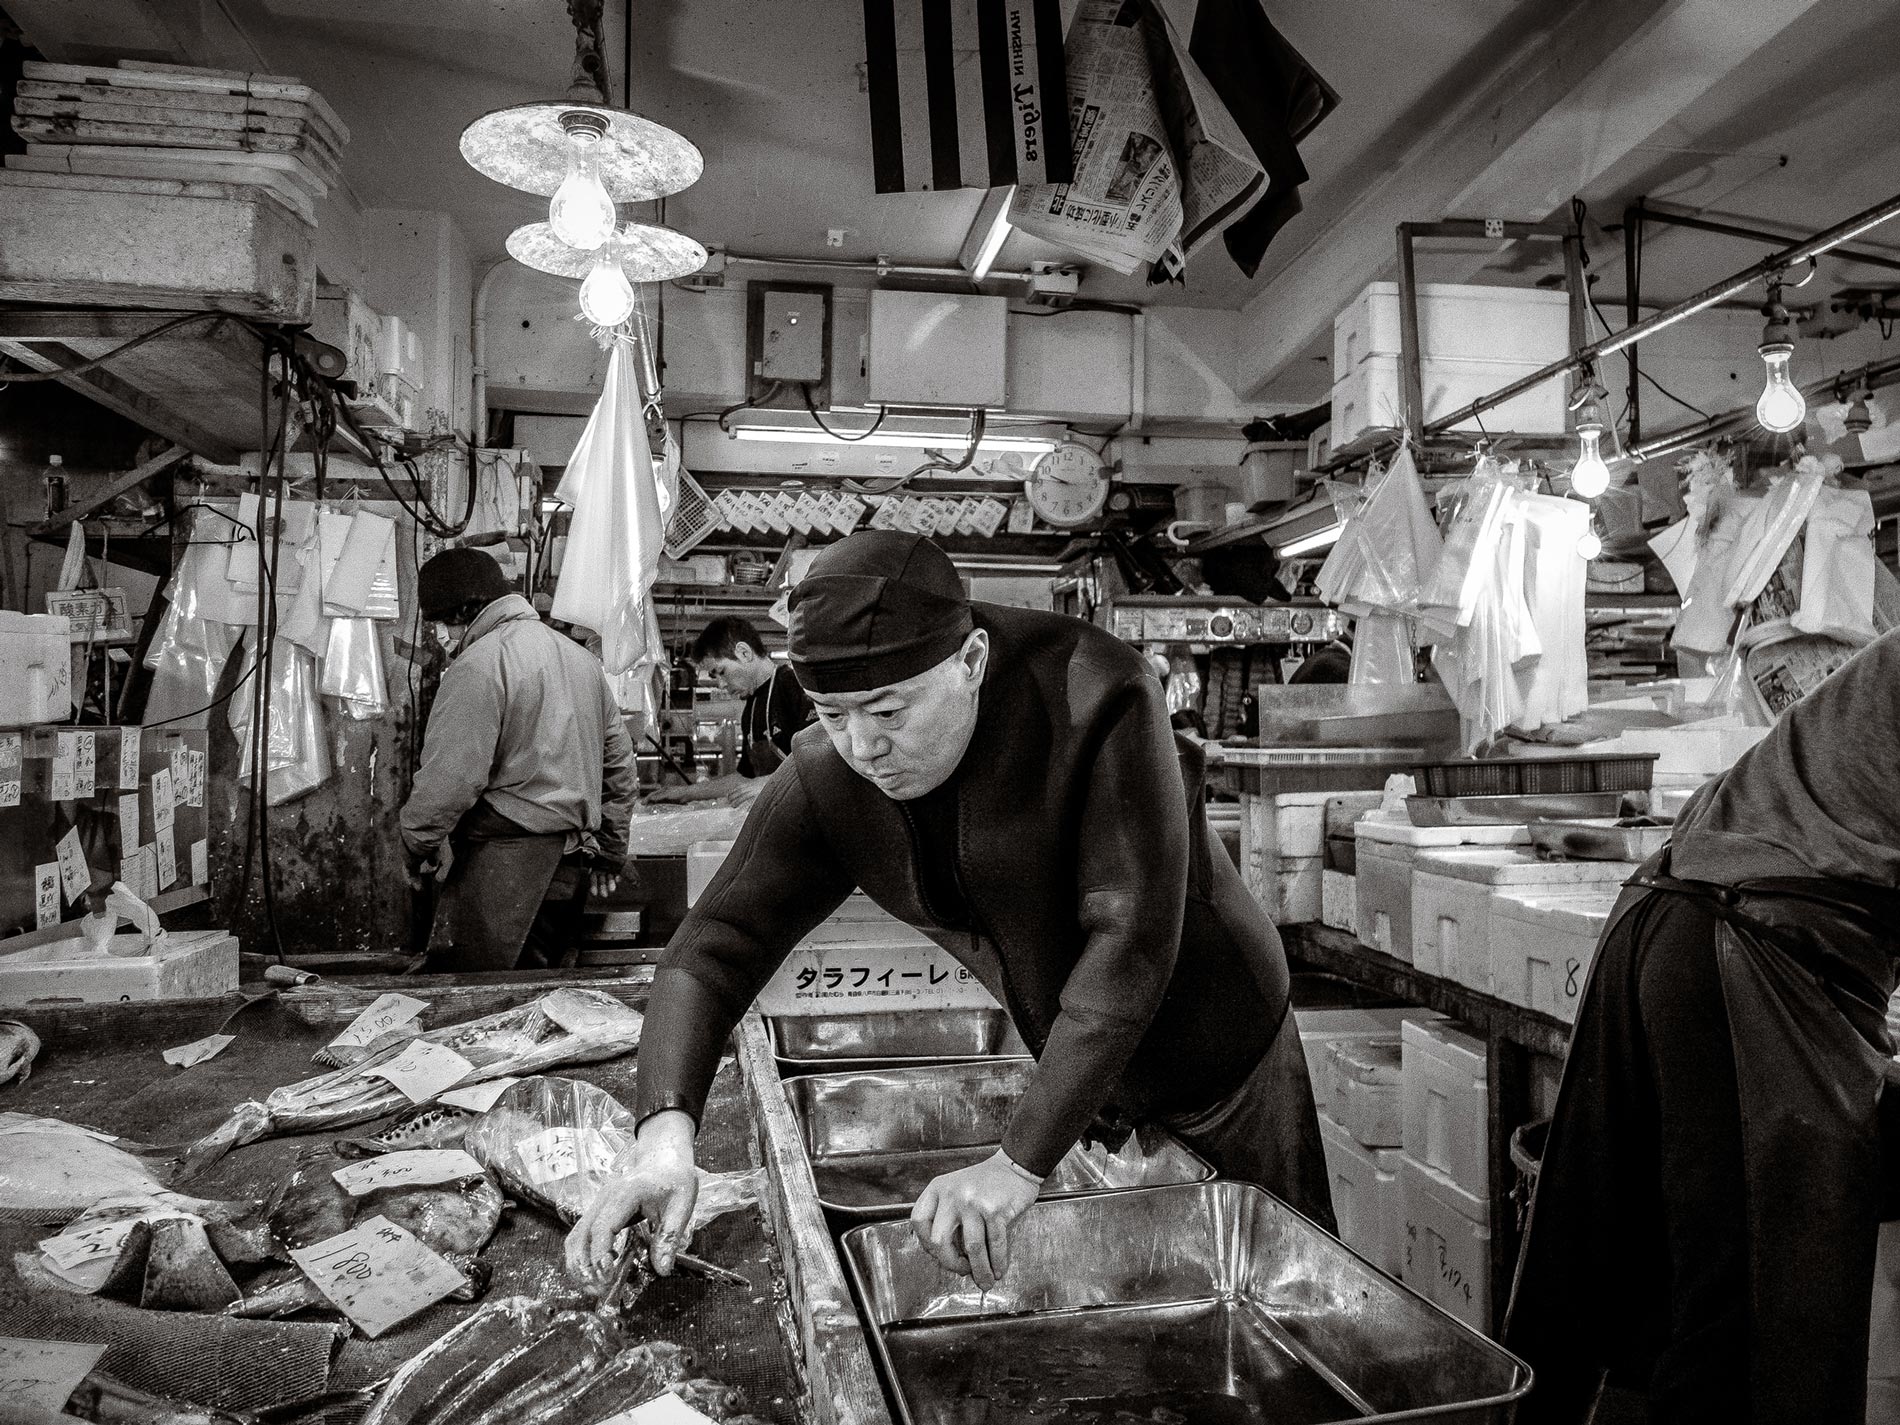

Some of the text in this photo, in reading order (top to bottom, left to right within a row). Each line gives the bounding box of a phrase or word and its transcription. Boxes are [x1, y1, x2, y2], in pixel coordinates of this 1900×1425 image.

[796, 964, 949, 990] タラフィーレ
[1565, 957, 1580, 998] 8
[309, 1243, 372, 1280] 1800
